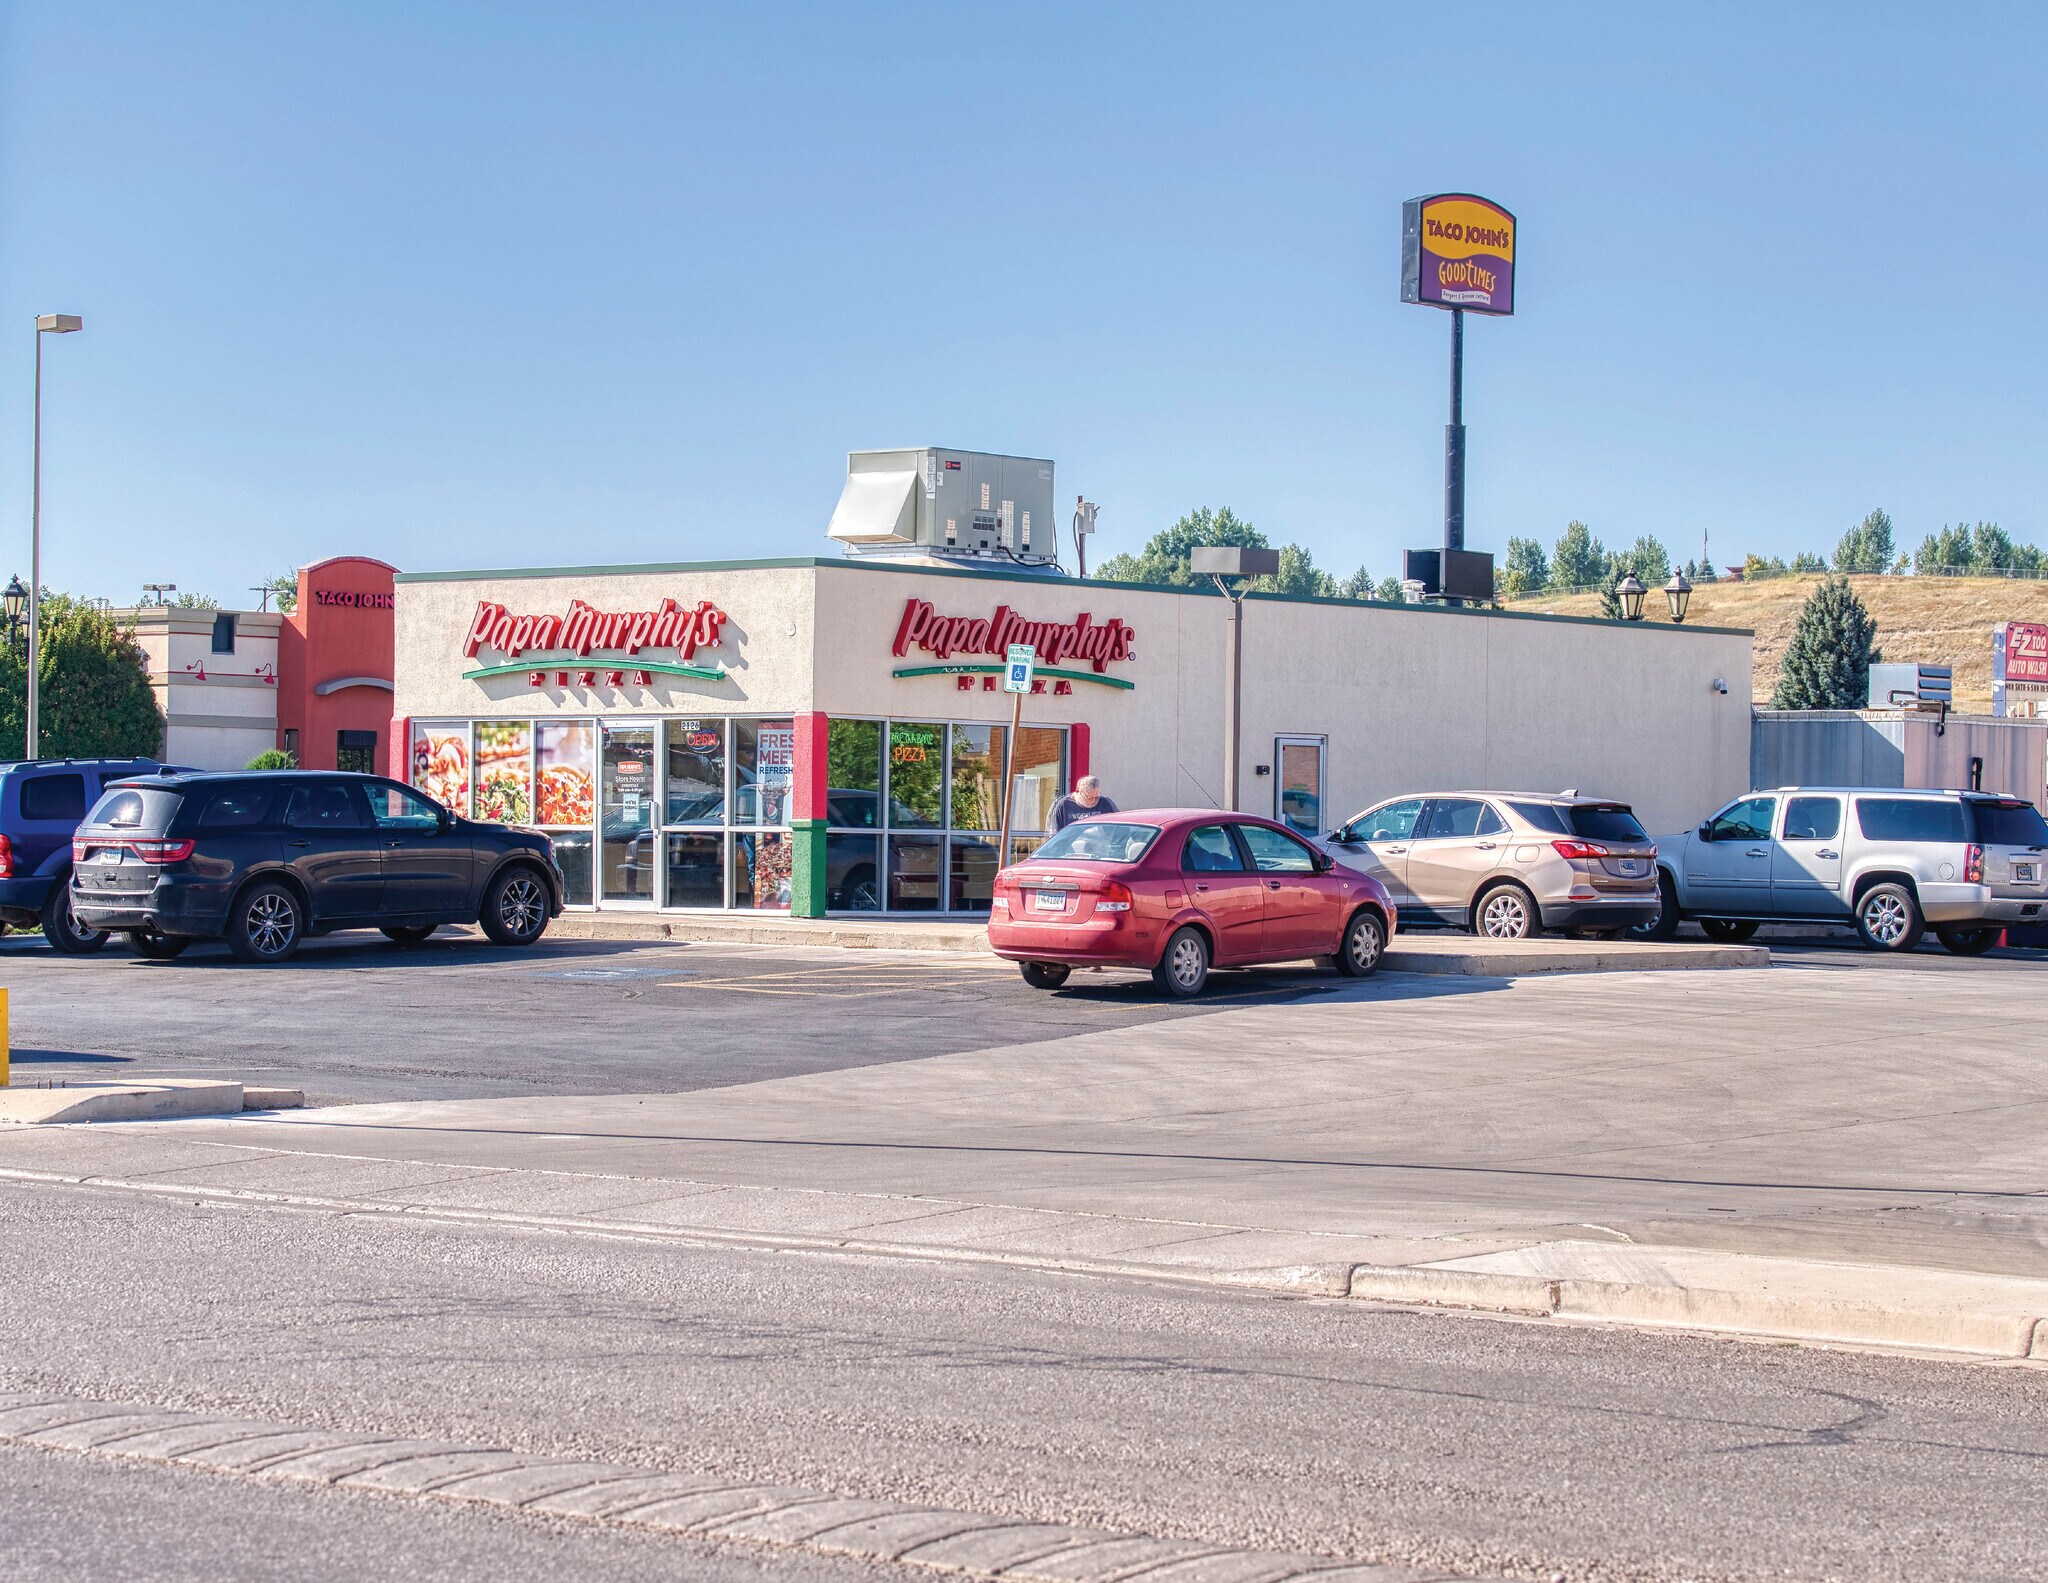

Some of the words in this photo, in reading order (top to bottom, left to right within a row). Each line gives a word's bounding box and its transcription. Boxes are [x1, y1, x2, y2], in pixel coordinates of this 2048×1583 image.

[1427, 219, 1463, 240] TACO
[1465, 226, 1509, 249] JOHN'S
[316, 591, 355, 605] TACO
[463, 601, 562, 658] Papa
[557, 598, 726, 660] Murphy's
[892, 598, 990, 657] Papa
[2032, 636, 2047, 650] TOO
[1010, 656, 1031, 664] PARKING
[2007, 660, 2026, 674] AUTO
[2027, 661, 2048, 676] WASH
[528, 671, 652, 687] PIZZA
[958, 675, 1073, 696] PIZA
[681, 721, 700, 730] 2126
[687, 733, 717, 746] OPEN
[894, 747, 927, 762] PIZZA
